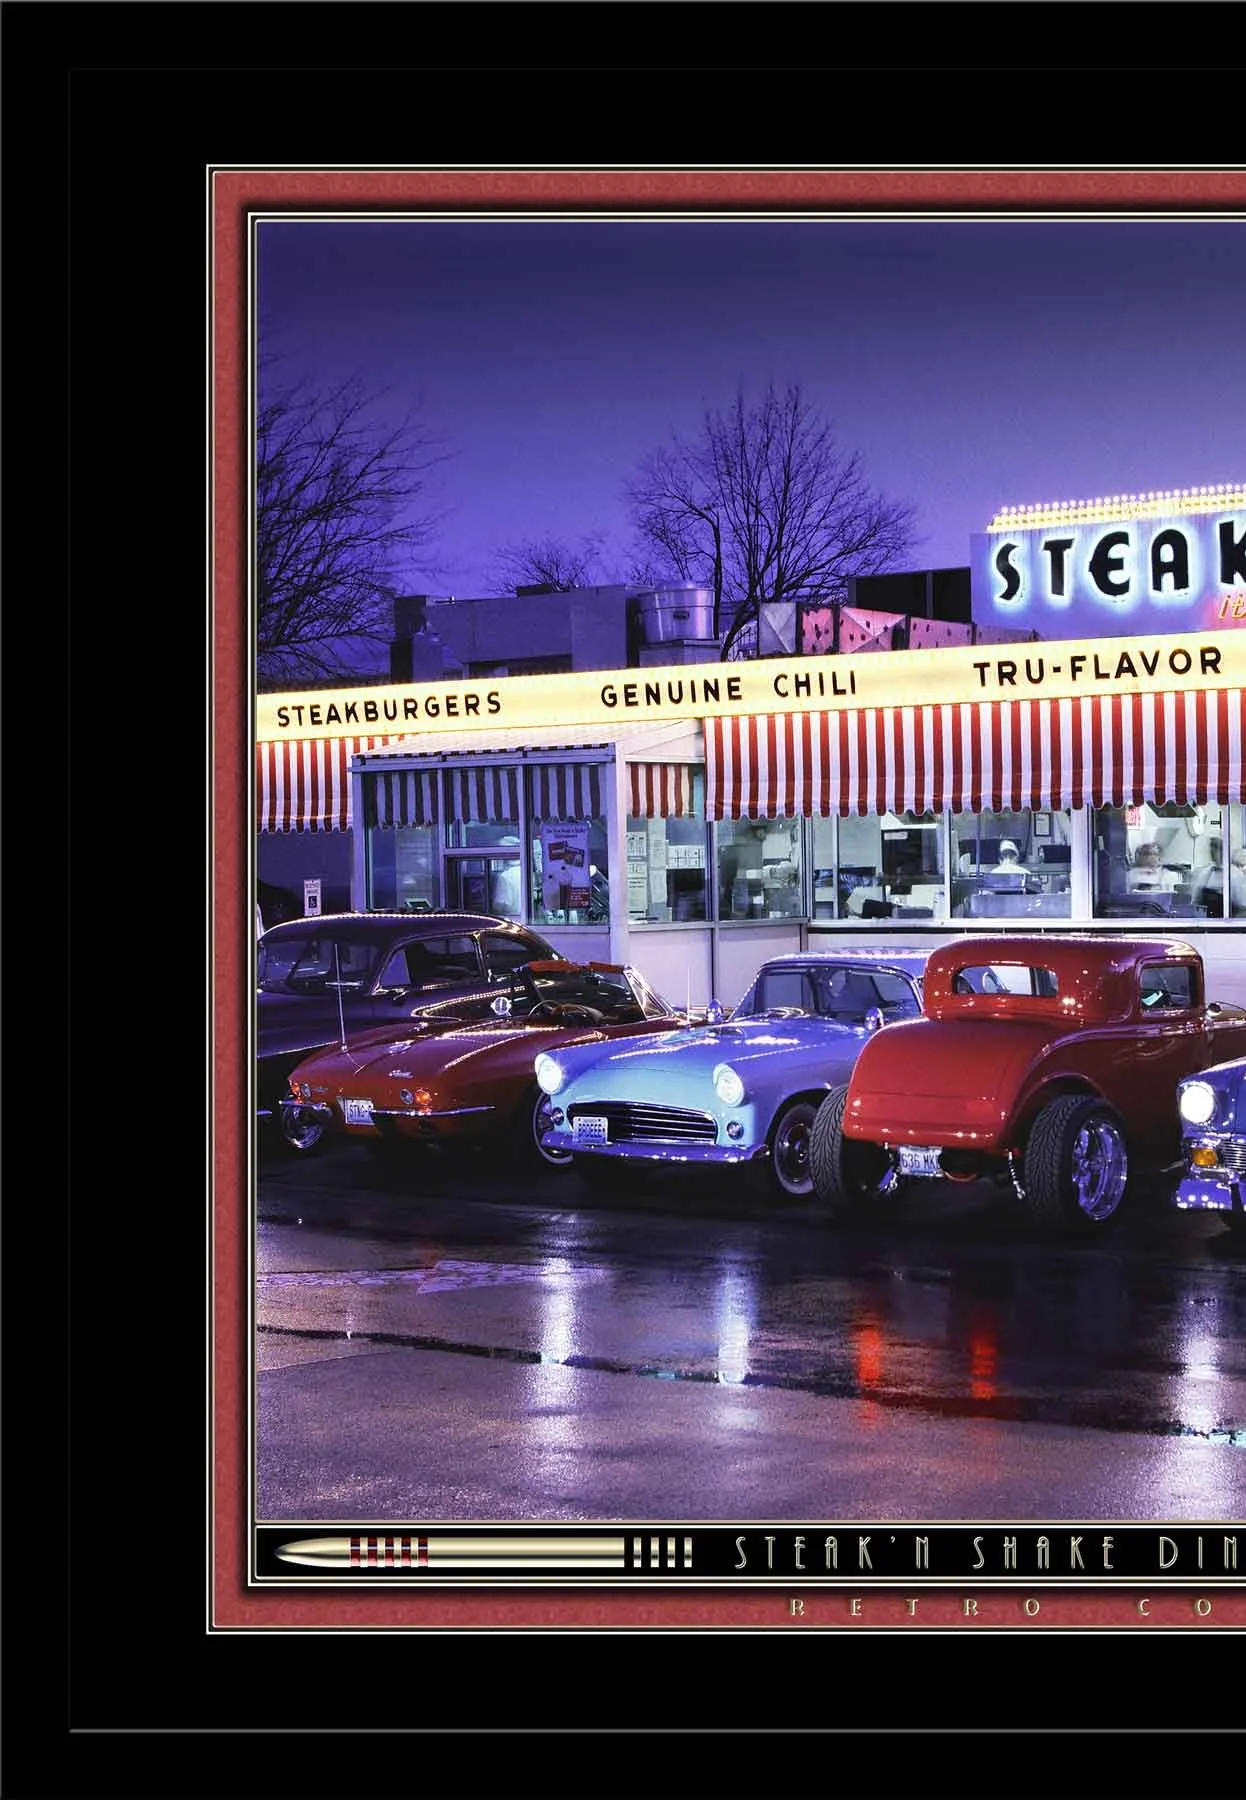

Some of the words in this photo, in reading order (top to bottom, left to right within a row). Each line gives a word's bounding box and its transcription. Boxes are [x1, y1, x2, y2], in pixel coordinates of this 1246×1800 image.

[973, 646, 1222, 687] TRU-FLAVOR
[601, 677, 743, 708] GENUINE
[774, 670, 856, 698] CHILI
[277, 691, 502, 727] STEAKBURGERS
